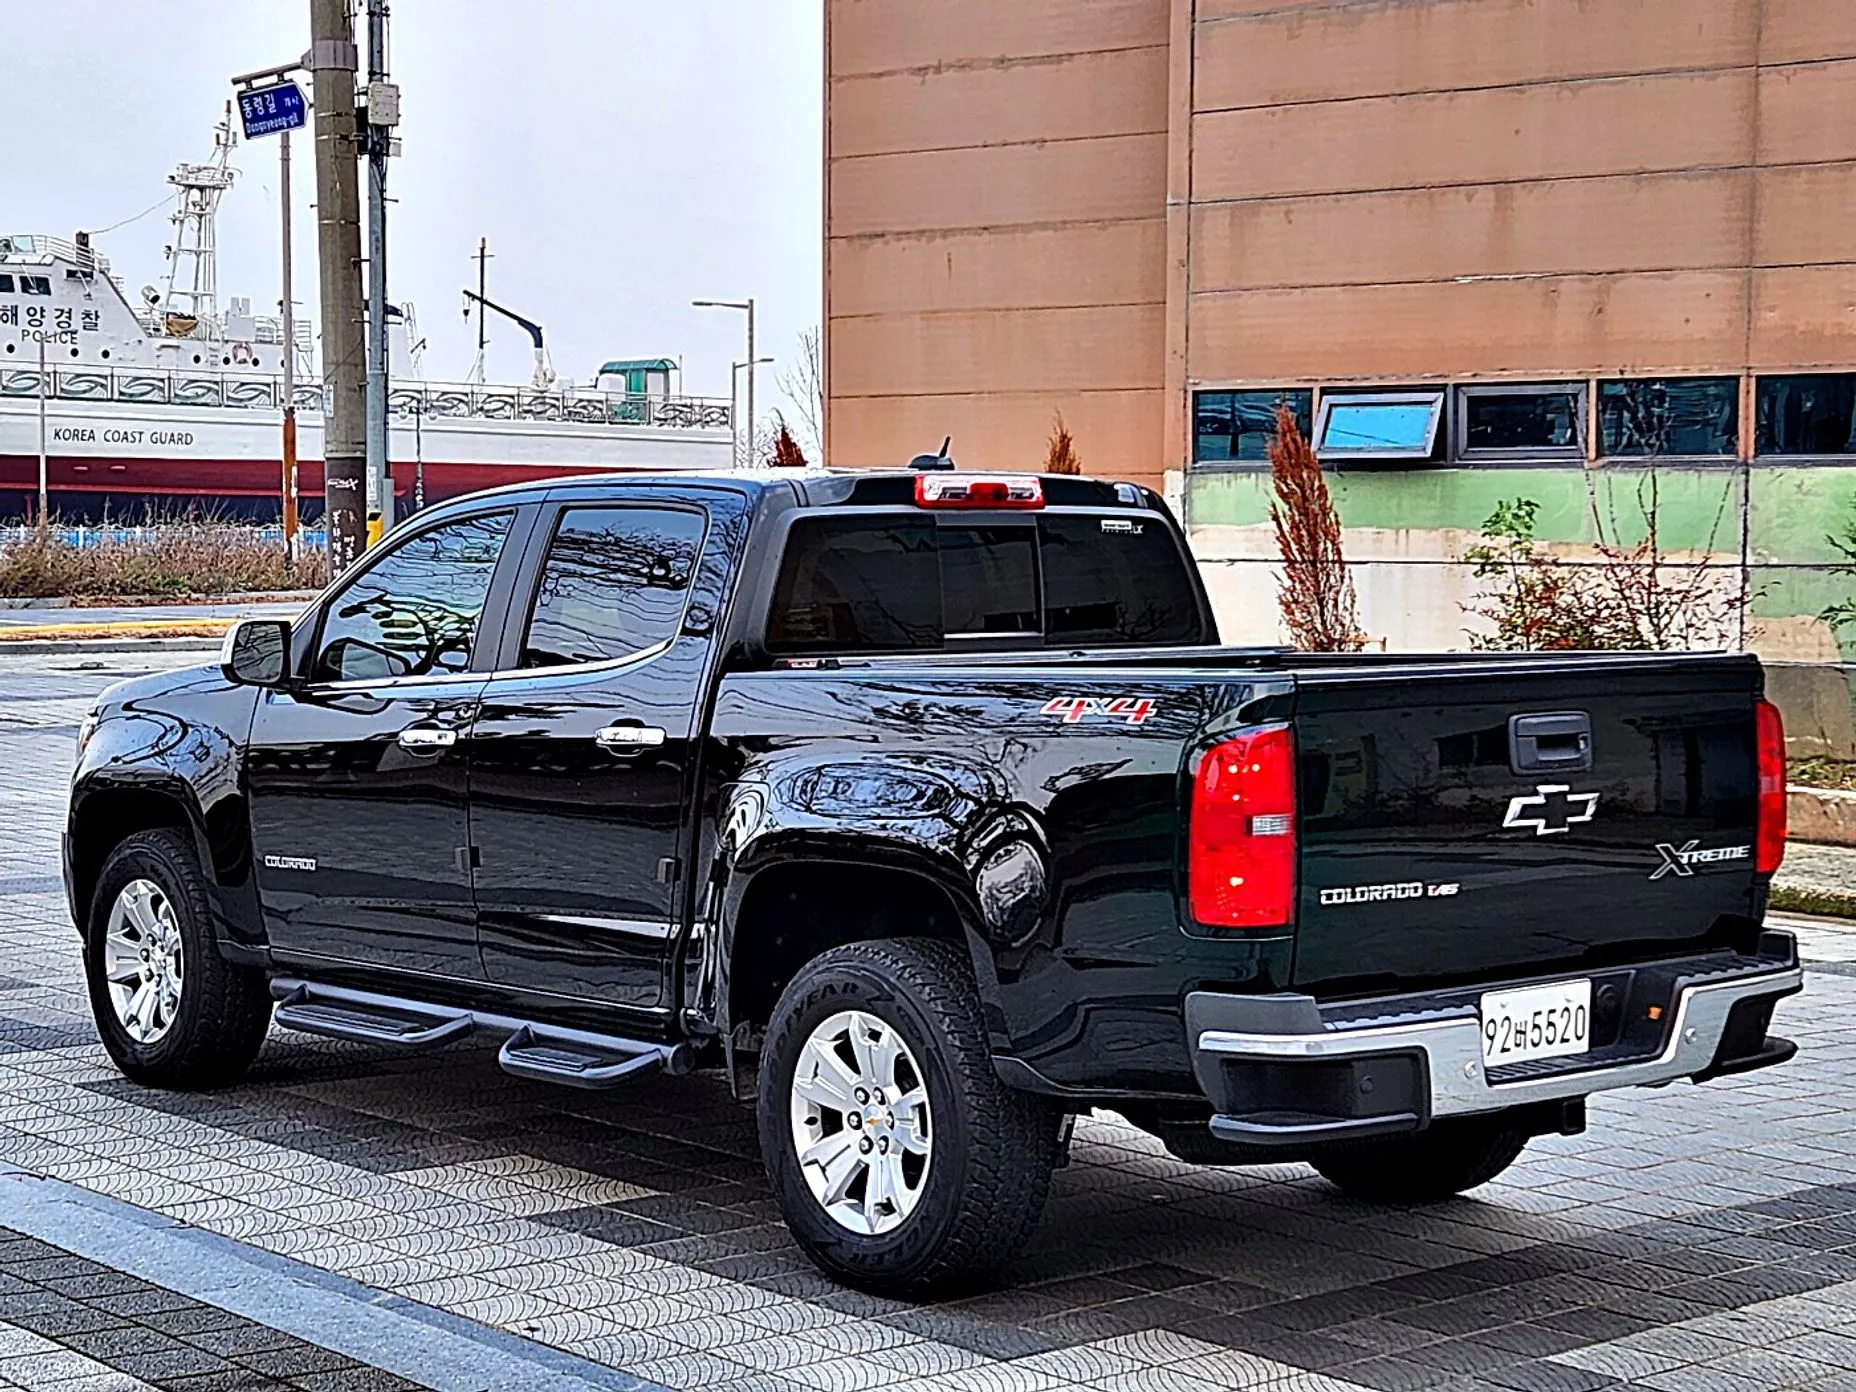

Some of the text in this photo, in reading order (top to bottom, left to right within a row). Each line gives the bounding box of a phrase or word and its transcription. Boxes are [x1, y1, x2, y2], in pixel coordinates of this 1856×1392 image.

[0, 305, 101, 332] 해양경찰
[21, 328, 78, 345] POLICE
[53, 428, 194, 446] KOREA COAST GUARD
[265, 855, 316, 870] COLORADO
[1320, 882, 1423, 905] COLORADO
[1485, 1004, 1586, 1057] 92버5520
